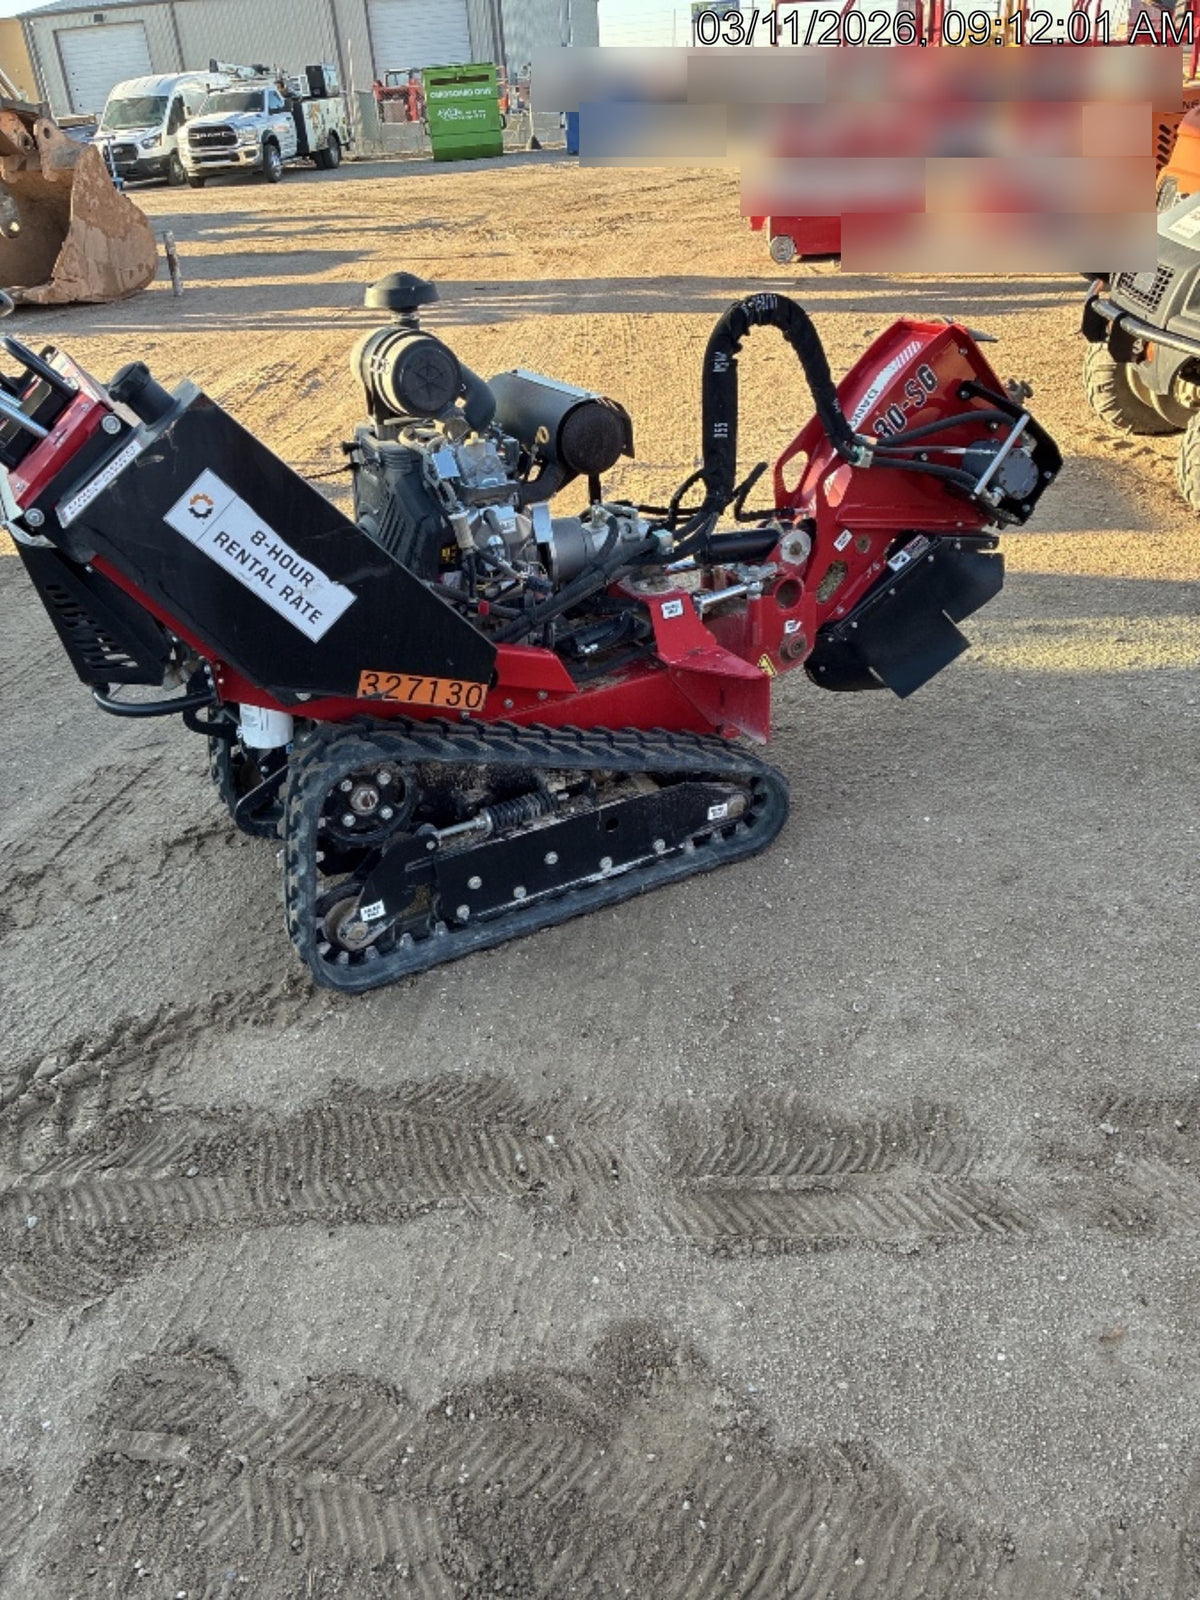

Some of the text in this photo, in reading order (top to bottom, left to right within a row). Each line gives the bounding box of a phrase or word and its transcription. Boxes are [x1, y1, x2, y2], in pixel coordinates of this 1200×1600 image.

[213, 531, 323, 624] RENTAL RATE
[250, 530, 314, 587] 8-HOUR
[362, 674, 482, 708] 327130
